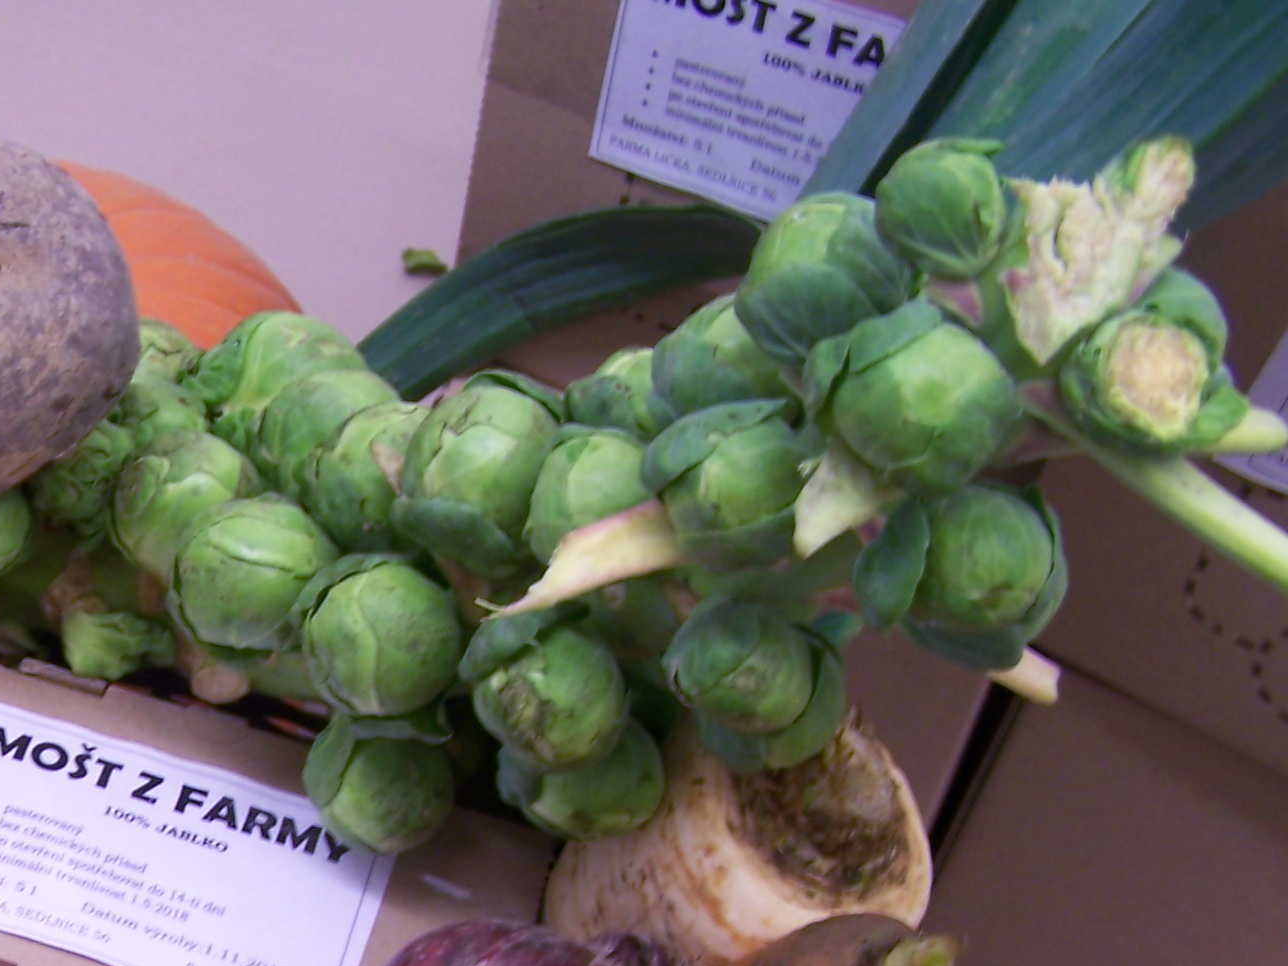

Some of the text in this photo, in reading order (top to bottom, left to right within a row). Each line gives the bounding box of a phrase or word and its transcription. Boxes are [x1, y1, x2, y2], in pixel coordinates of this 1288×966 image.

[785, 9, 816, 49] Z
[763, 52, 806, 78] 100%
[750, 158, 801, 186] Datum
[103, 805, 229, 854] 100% JABLKO
[132, 771, 165, 806] Z
[174, 784, 351, 864] FARMY
[23, 826, 102, 858] chemických
[11, 839, 65, 863] otevření
[67, 857, 145, 890] spotřebovat
[147, 882, 166, 898] do
[55, 868, 127, 900] trvanlivost
[80, 901, 139, 931] Datum
